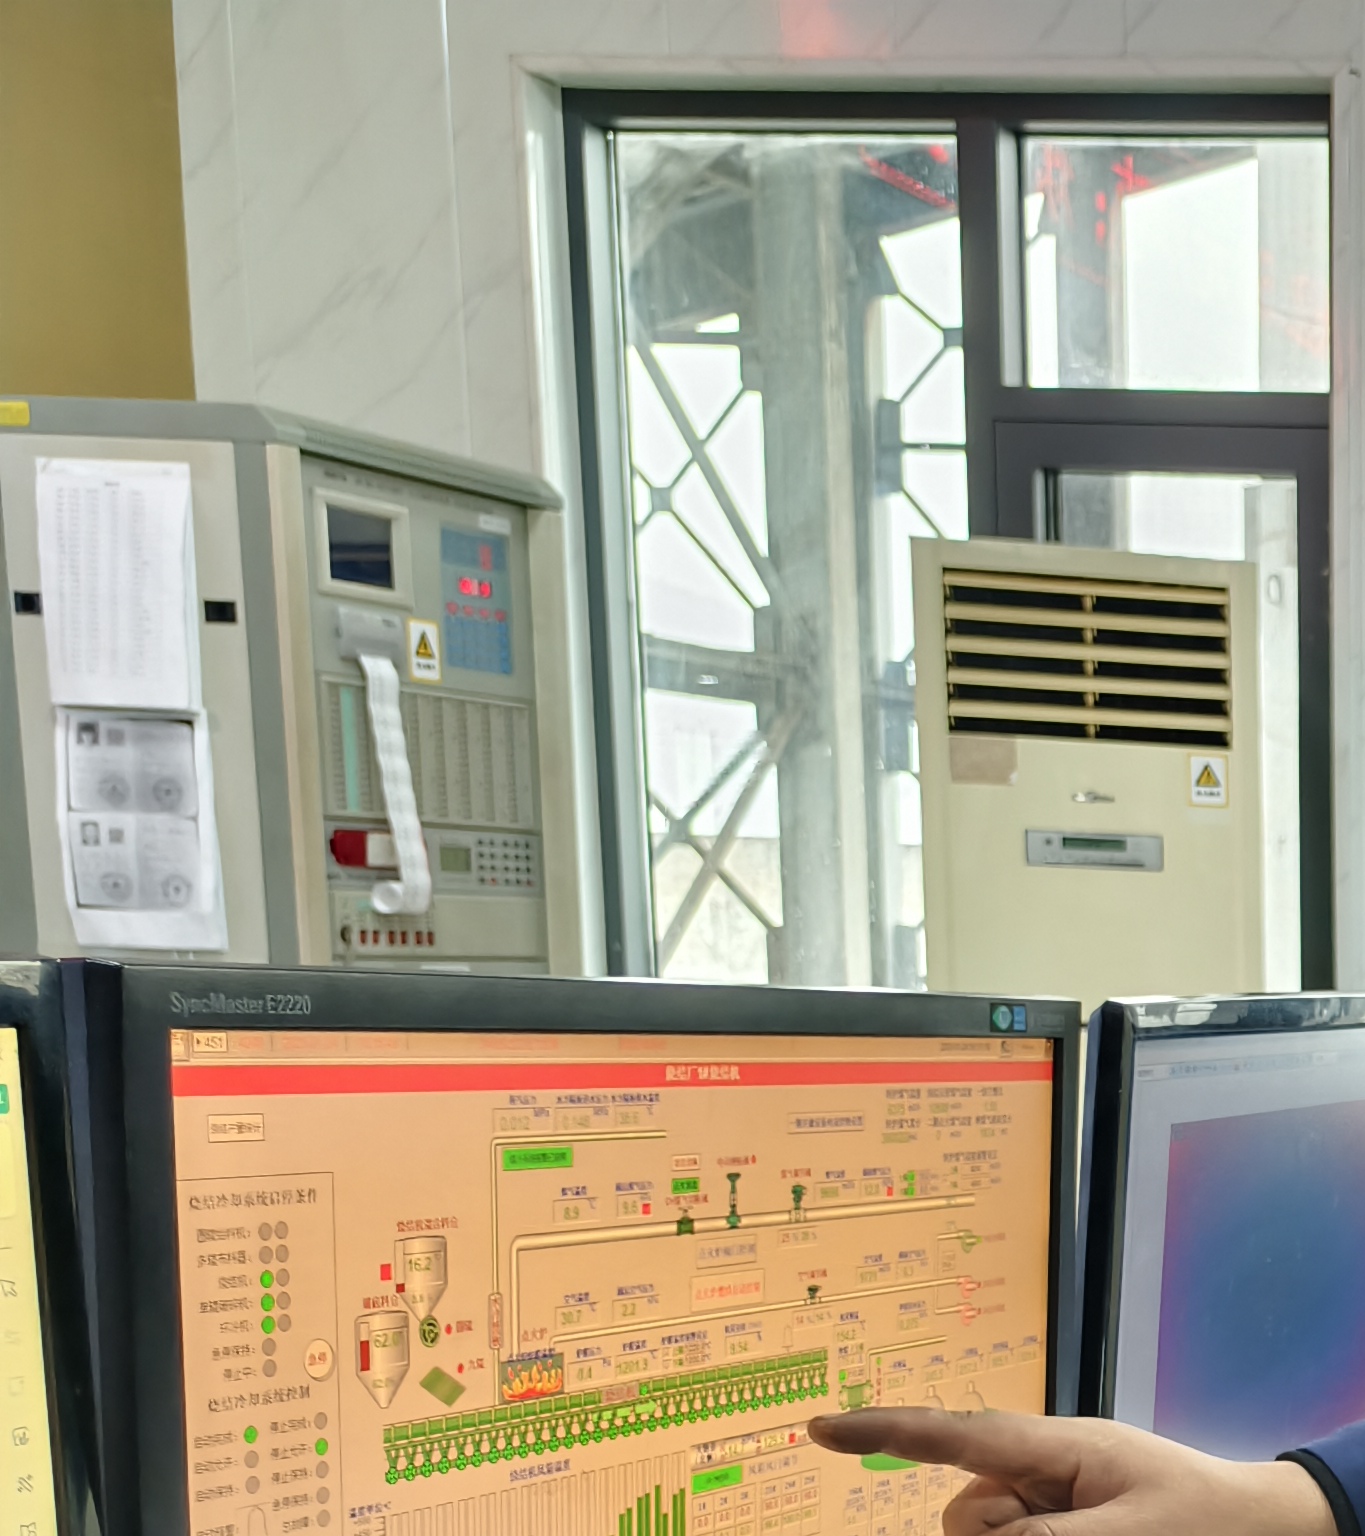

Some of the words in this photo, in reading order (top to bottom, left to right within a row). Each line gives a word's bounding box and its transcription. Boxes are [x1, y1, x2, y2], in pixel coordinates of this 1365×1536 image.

[169, 992, 263, 1017] SyncMaster
[265, 995, 312, 1015] E2220
[408, 1257, 432, 1272] 16.2
